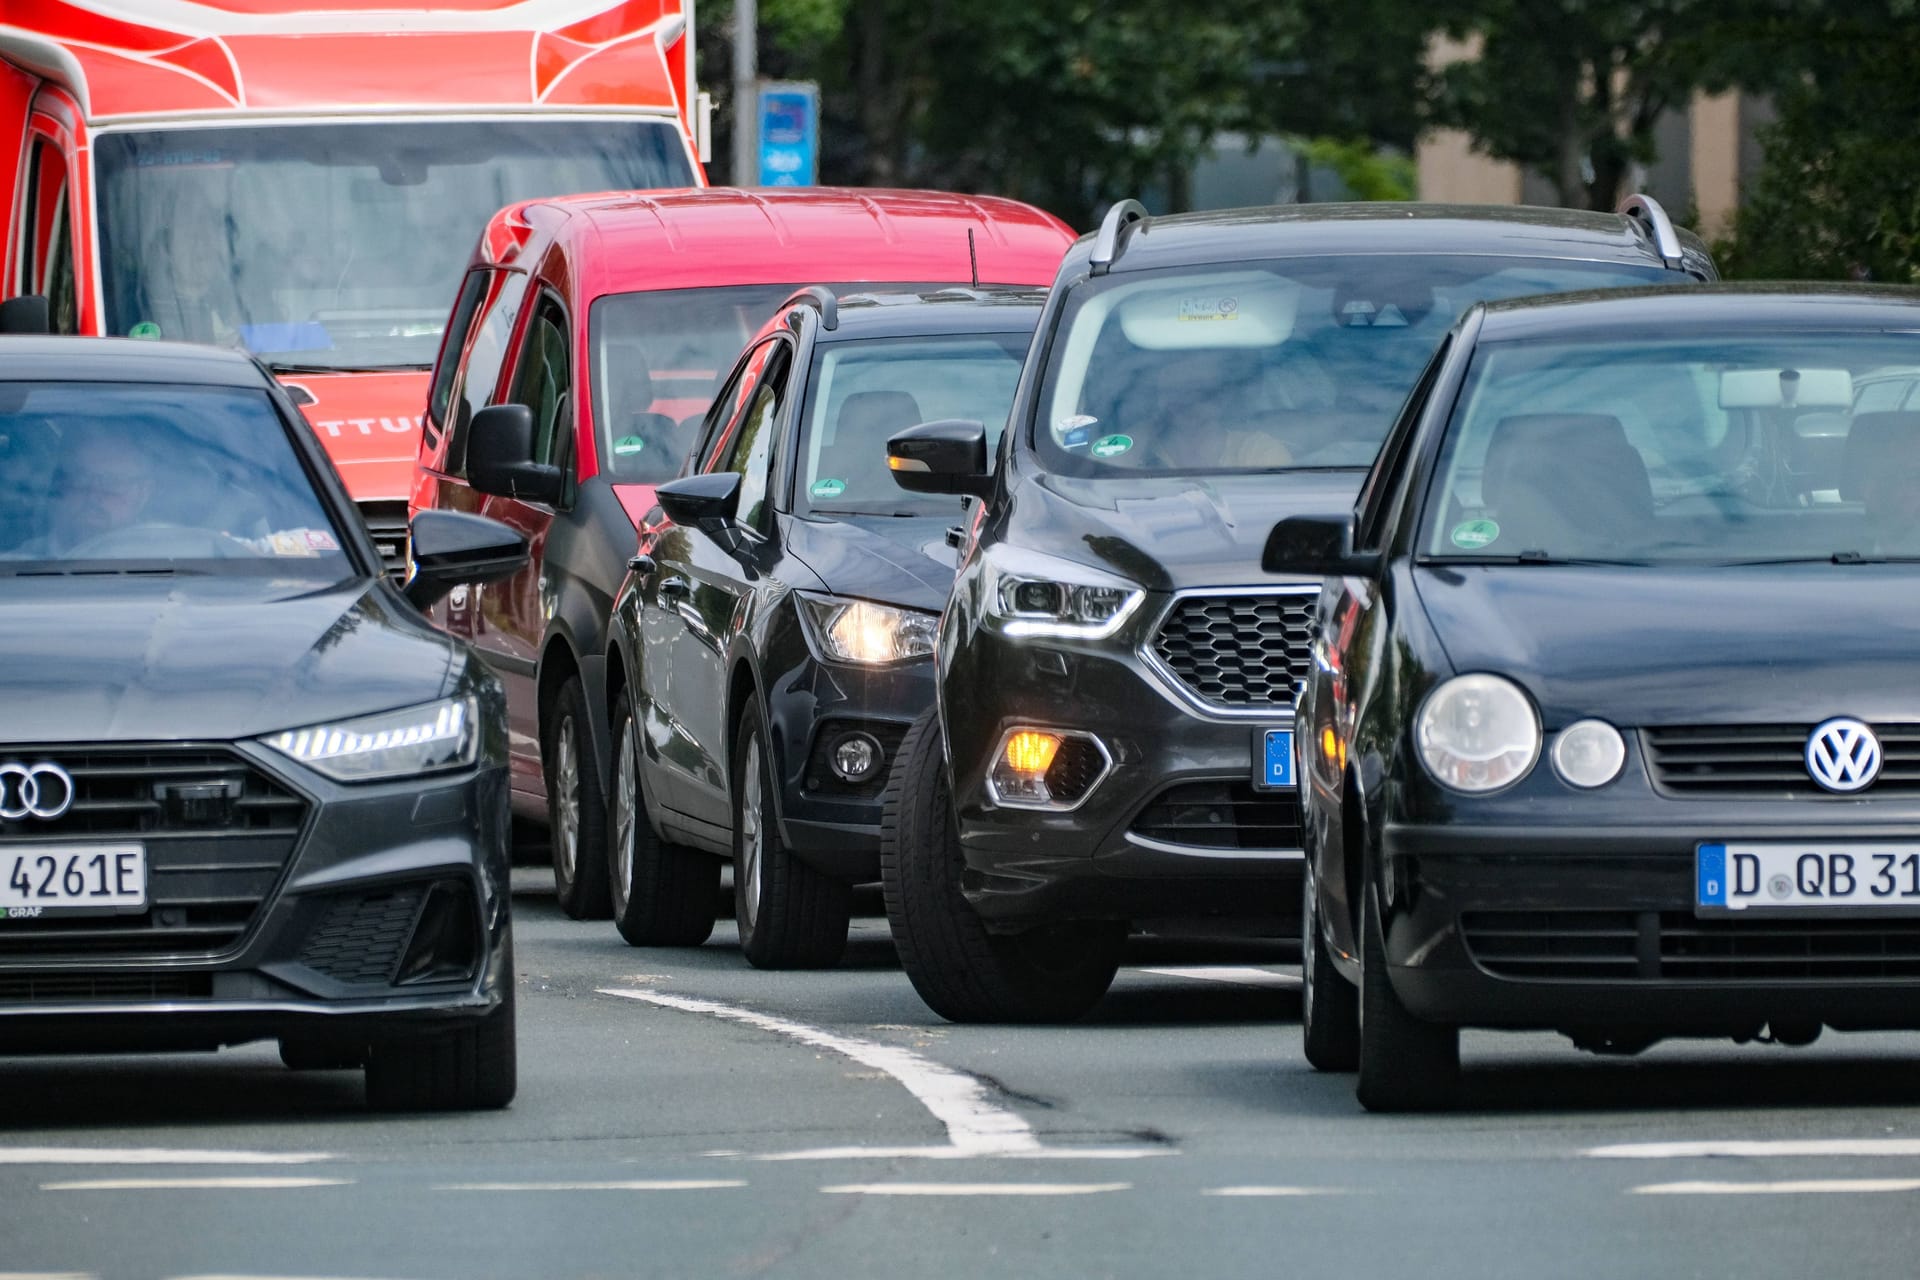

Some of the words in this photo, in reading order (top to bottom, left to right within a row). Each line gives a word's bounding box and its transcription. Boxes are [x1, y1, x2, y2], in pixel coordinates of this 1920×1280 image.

[823, 479, 833, 489] 4
[1808, 719, 1881, 791] VW
[1273, 763, 1284, 776] D
[10, 853, 139, 898] 4261E
[1733, 853, 1761, 896] D
[1796, 853, 1857, 897] QB
[8, 907, 42, 918] GRAF
